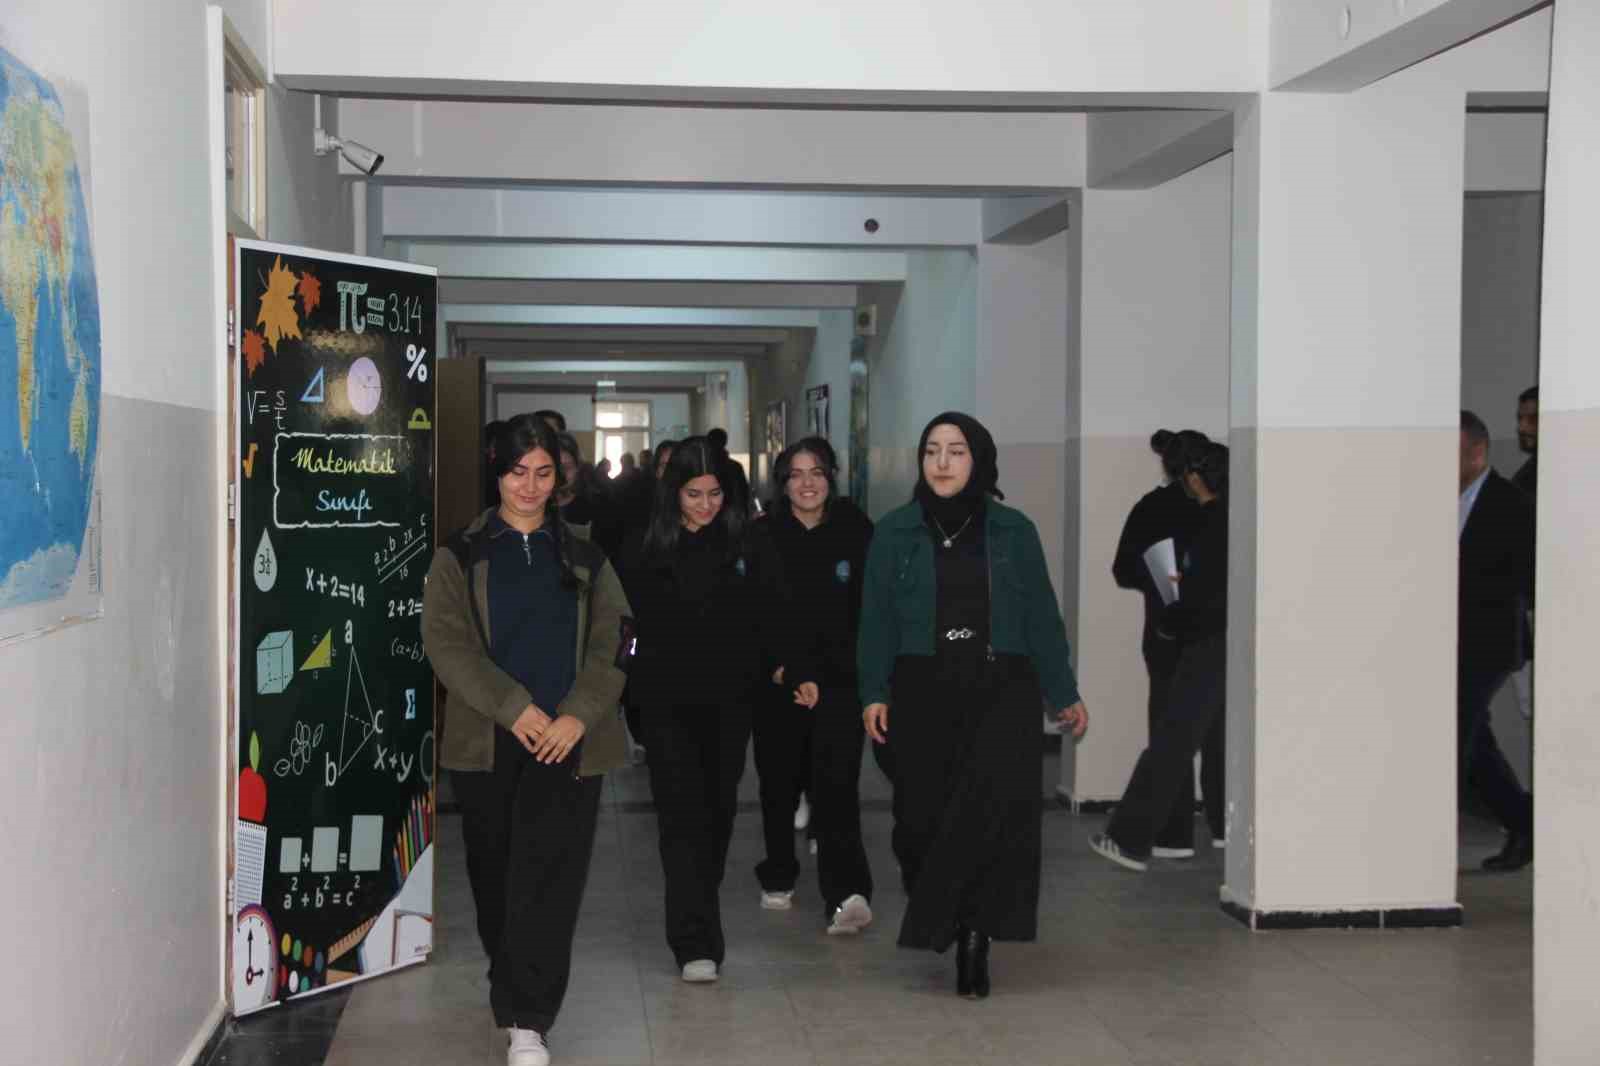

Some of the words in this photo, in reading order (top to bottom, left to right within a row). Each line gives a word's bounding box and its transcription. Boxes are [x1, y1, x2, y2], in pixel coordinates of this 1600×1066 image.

[406, 344, 427, 382] %
[290, 447, 397, 475] Matematik
[344, 619, 353, 645] a
[324, 751, 337, 788] b
